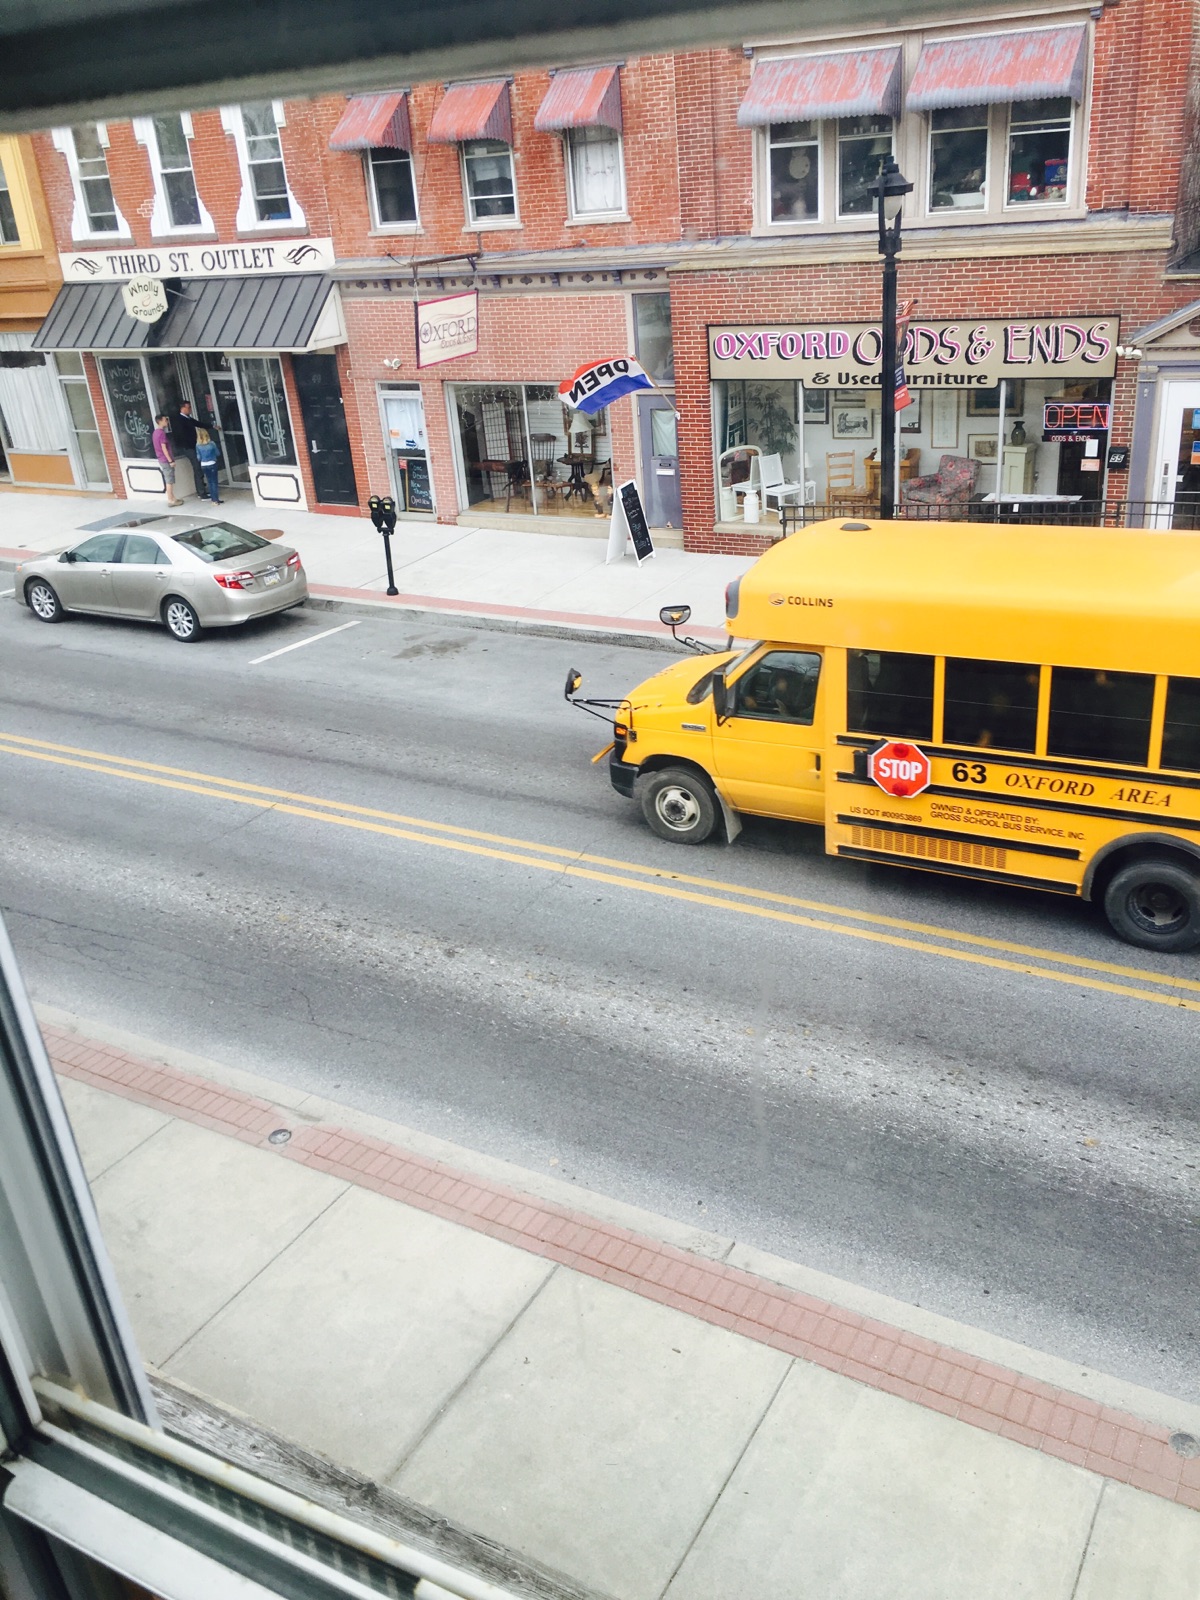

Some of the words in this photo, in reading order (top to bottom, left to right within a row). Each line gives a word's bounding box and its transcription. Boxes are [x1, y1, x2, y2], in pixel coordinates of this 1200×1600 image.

[106, 253, 161, 274] THIRD
[168, 252, 194, 273] ST.
[201, 247, 275, 271] OUTLET
[128, 281, 159, 297] Wholly
[132, 303, 164, 317] Grounds
[420, 316, 477, 344] OXFORD
[714, 330, 850, 360] OXFORD
[965, 325, 996, 366] &
[1003, 322, 1111, 364] ENDS
[812, 372, 830, 385] &
[837, 372, 882, 385] Used
[890, 372, 988, 385] rniture
[1046, 405, 1109, 428] OPEN
[1109, 453, 1125, 463] 55
[788, 596, 833, 608] COLLINS
[878, 758, 923, 781] STOP
[951, 762, 988, 785] 63
[1005, 773, 1095, 798] OXFORD
[1110, 788, 1172, 808] AREA
[850, 806, 861, 814] US
[863, 808, 880, 817] DOT
[930, 803, 964, 814] OWNED
[965, 807, 972, 815] &
[974, 809, 1023, 822] OPERATED
[930, 811, 961, 822] GROSS
[963, 816, 1001, 828] SCHOOL
[1003, 821, 1022, 831] BUS
[1067, 831, 1086, 840] INC.
